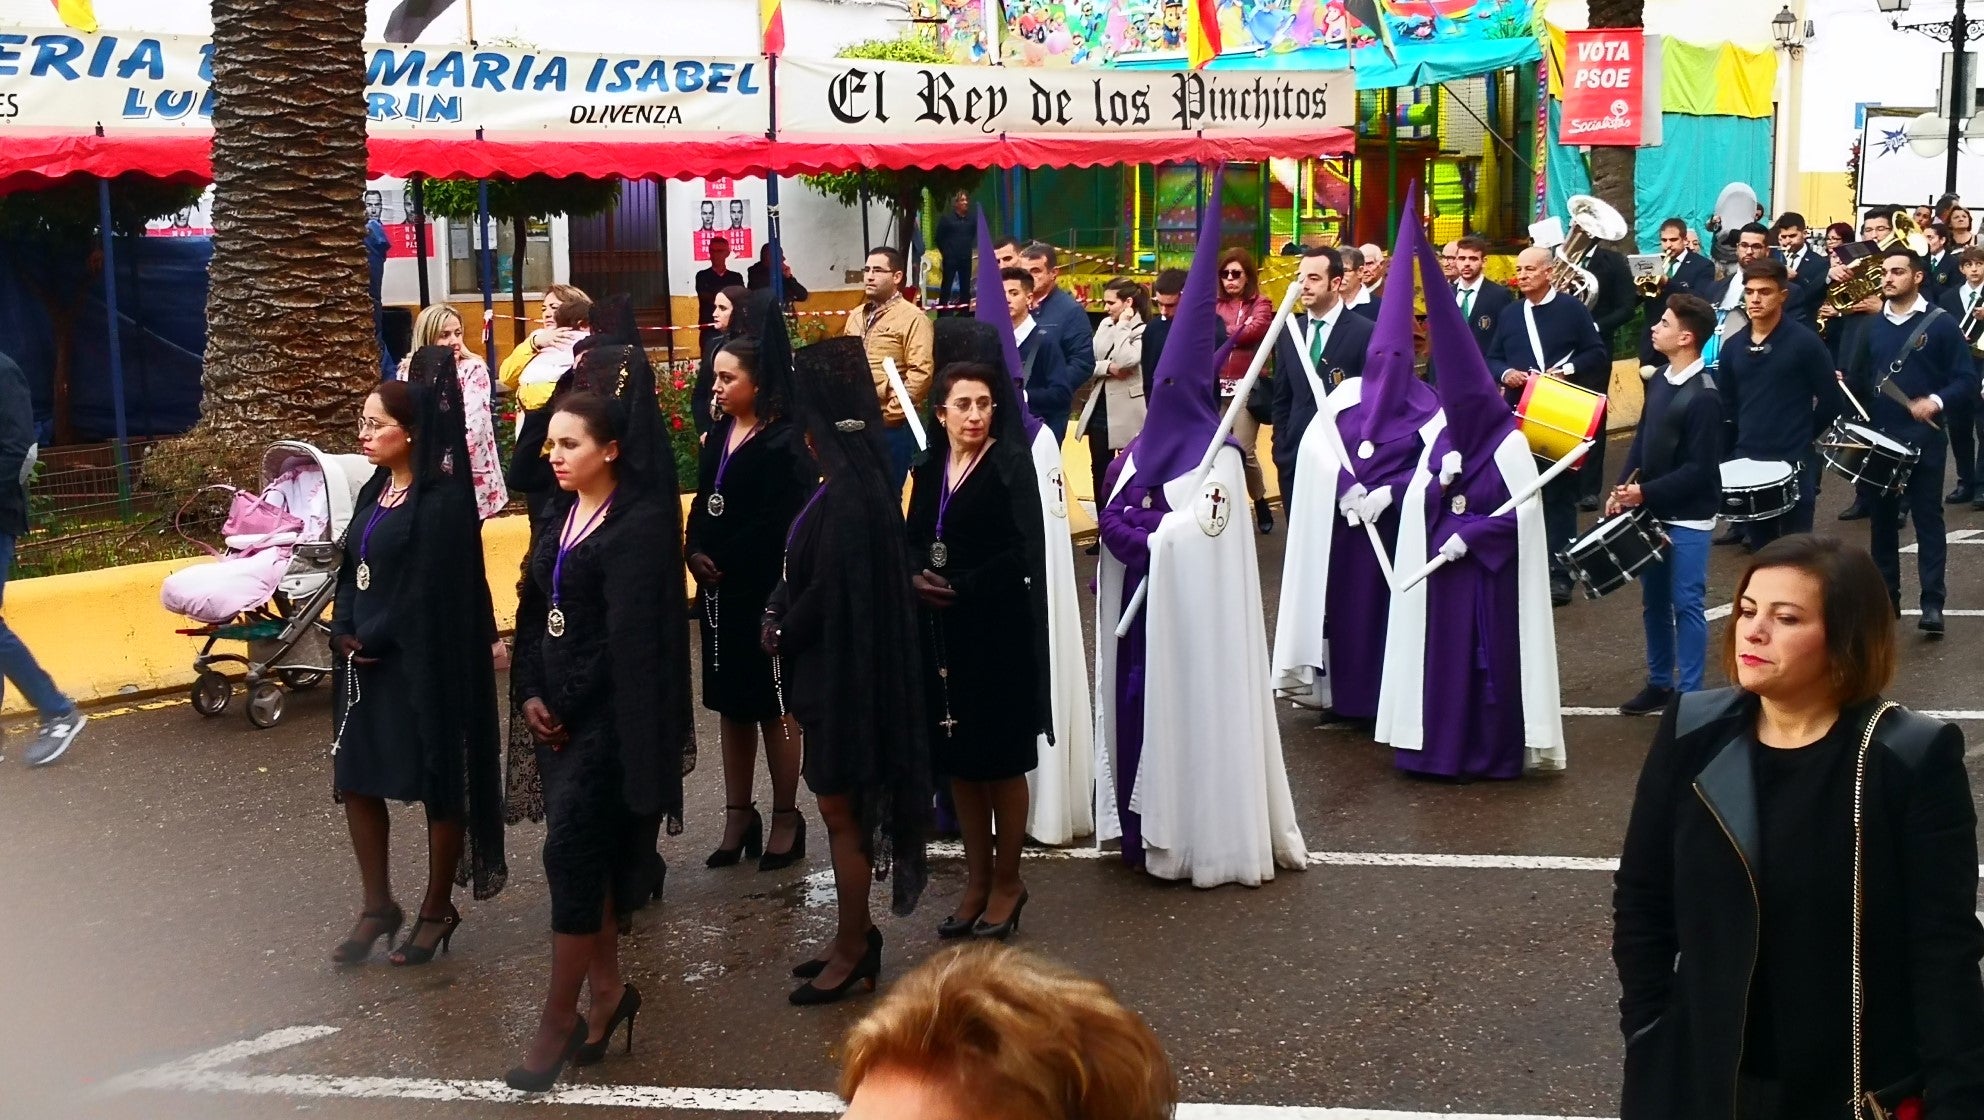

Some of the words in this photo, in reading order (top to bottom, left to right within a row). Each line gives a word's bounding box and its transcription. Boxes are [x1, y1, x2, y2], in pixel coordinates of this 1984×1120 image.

[1578, 41, 1630, 62] VOTA
[366, 48, 567, 92] MARIA
[585, 58, 759, 94] ISABEL
[1573, 67, 1632, 89] PSOE
[828, 67, 891, 124] El
[914, 69, 1008, 133] Rey
[1029, 77, 1073, 126] de
[1092, 77, 1150, 127] los
[1172, 72, 1328, 131] Pinchitos
[570, 104, 682, 124] OLIVENZA
